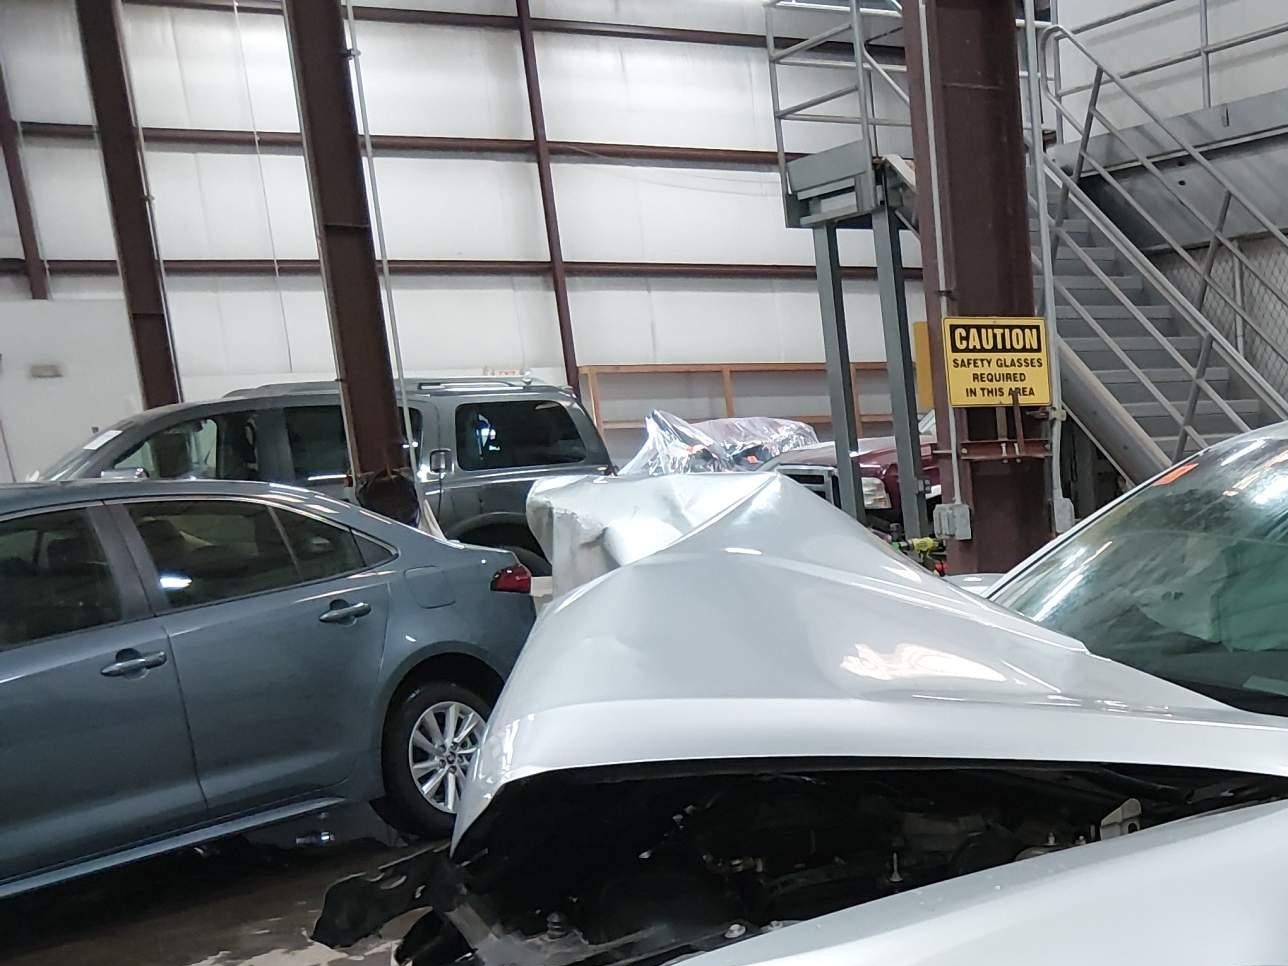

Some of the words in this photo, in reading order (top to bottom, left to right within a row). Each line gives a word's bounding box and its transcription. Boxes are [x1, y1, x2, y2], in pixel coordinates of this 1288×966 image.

[955, 328, 1038, 350] CAUTION
[953, 358, 992, 368] SAFETY
[995, 357, 1043, 368] GLASSES
[972, 372, 1027, 383] REQUIRED
[965, 387, 977, 398] IN
[980, 387, 1004, 397] THIS
[1008, 386, 1035, 397] AREA
